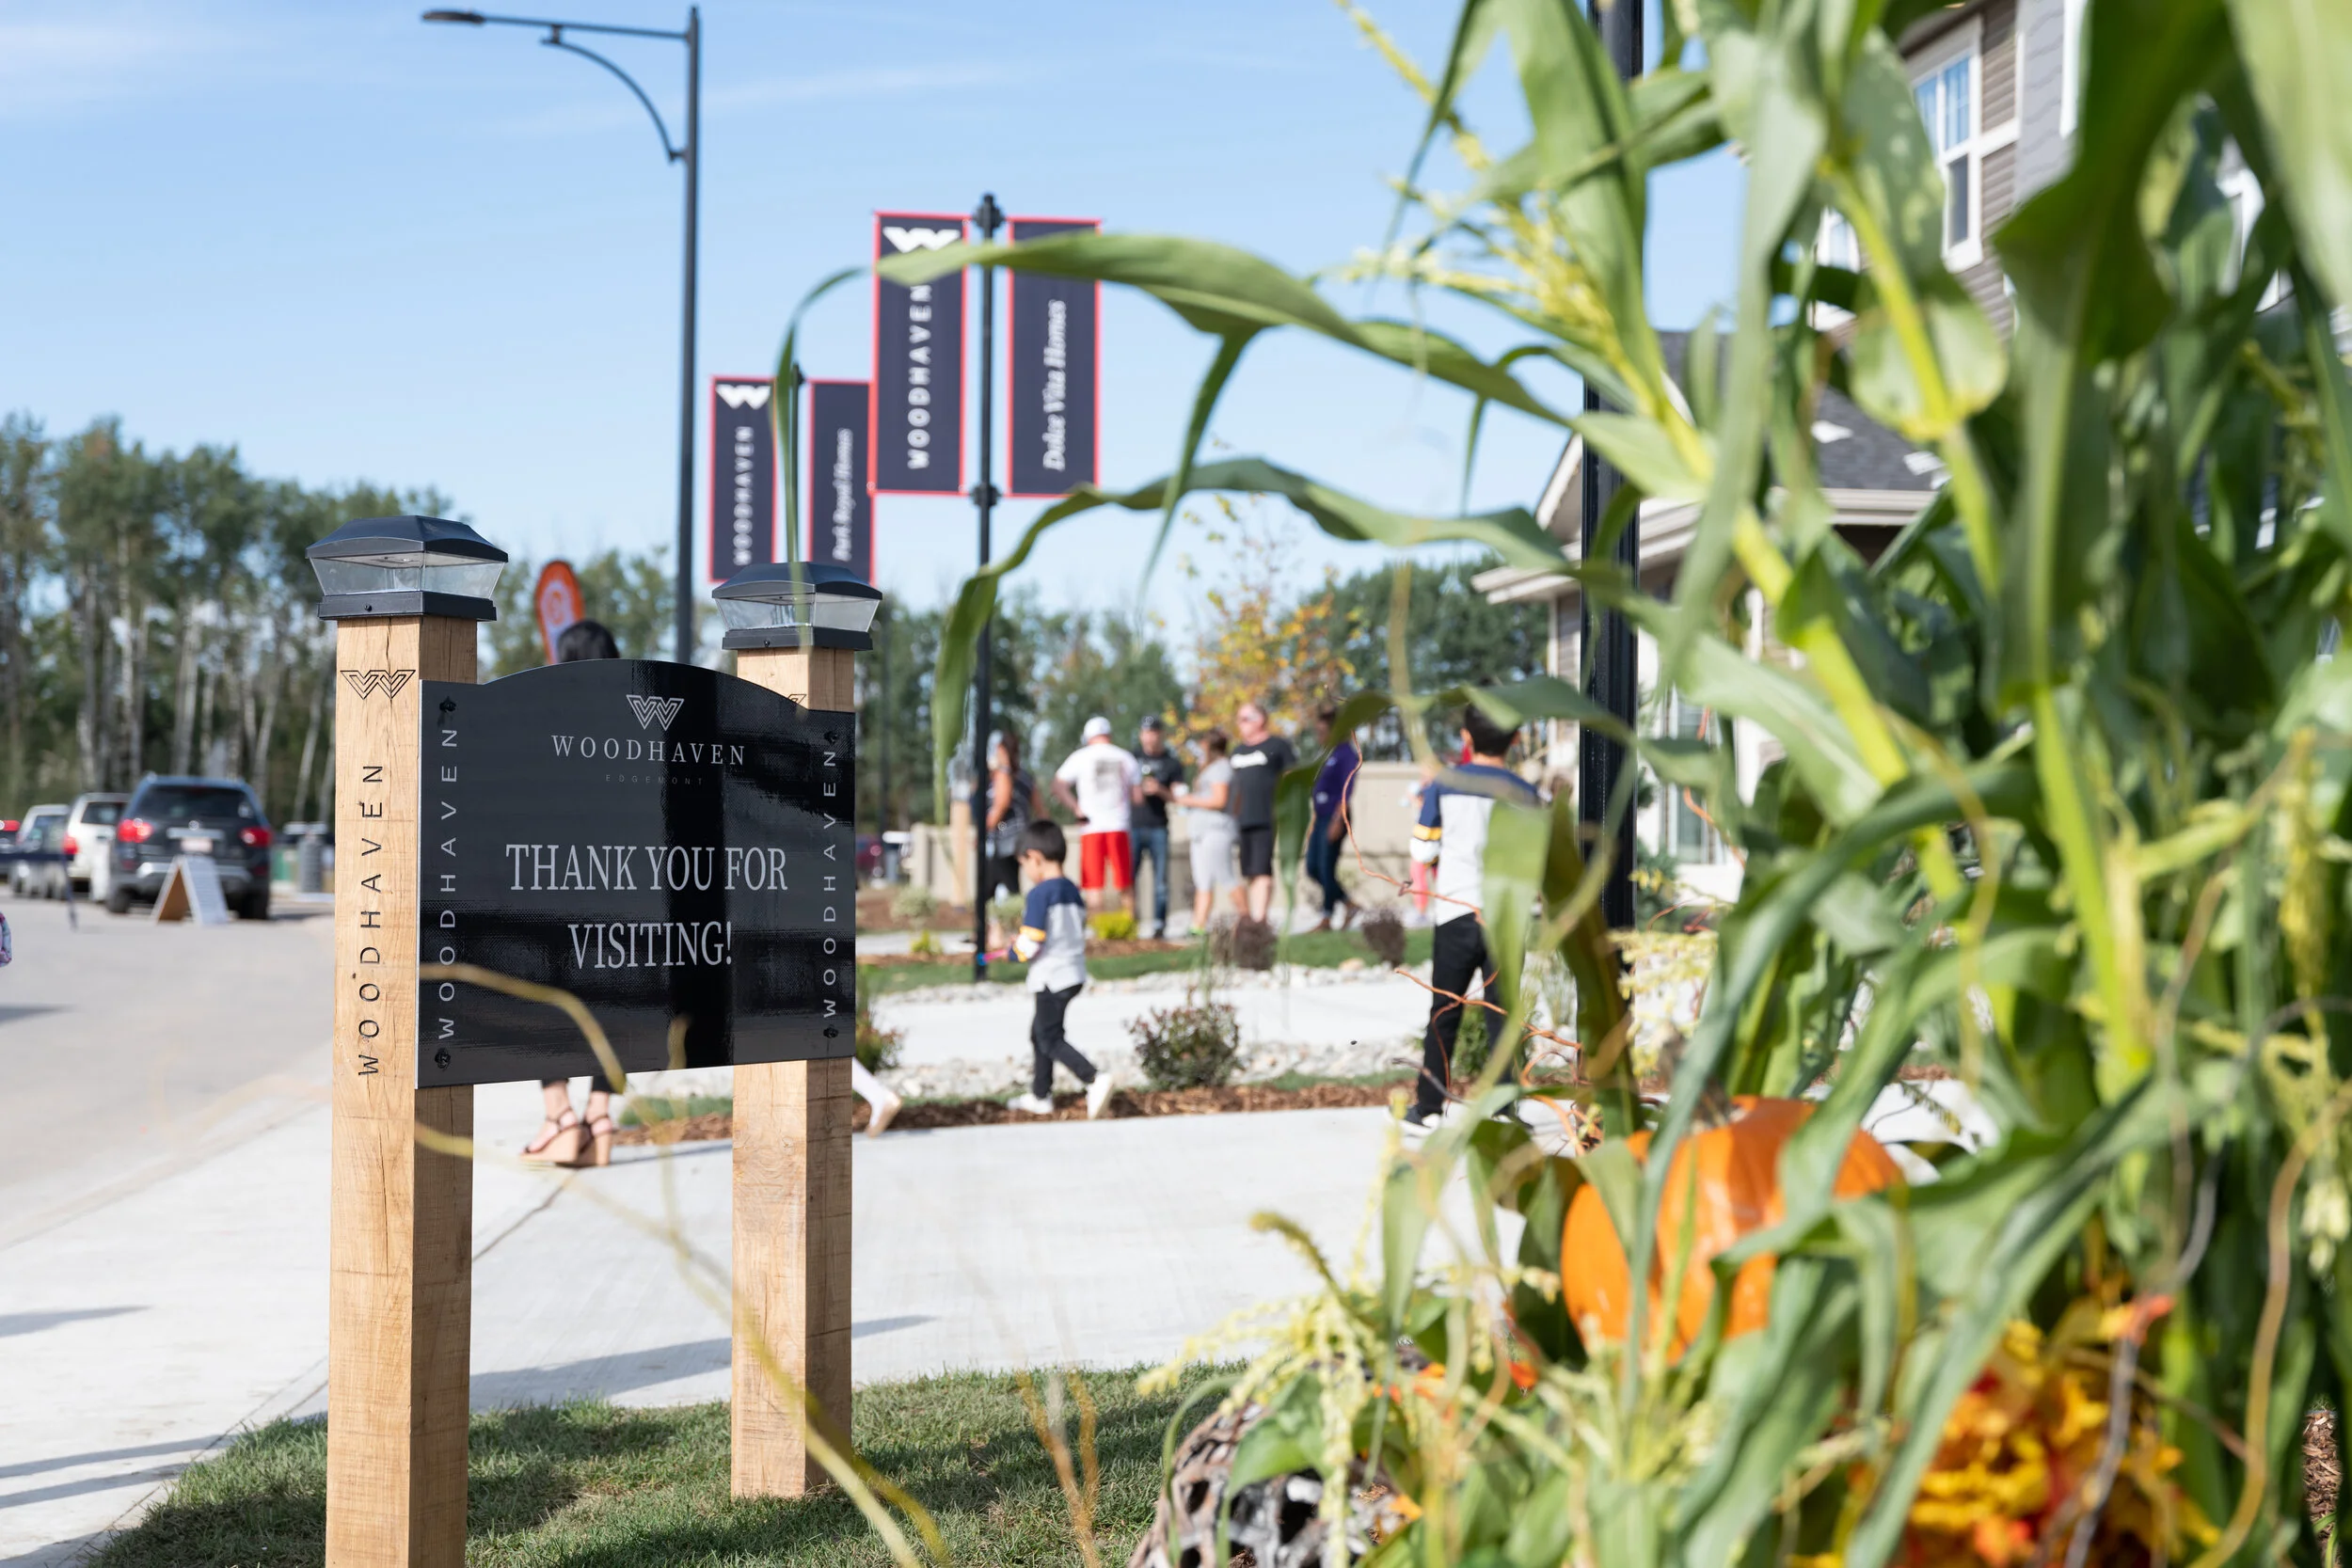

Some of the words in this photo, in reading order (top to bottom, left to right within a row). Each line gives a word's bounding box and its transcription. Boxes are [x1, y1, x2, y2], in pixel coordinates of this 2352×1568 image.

[1042, 299, 1067, 370] Homes
[907, 285, 931, 469] WOODHAVEN
[1041, 370, 1066, 413] Vita
[733, 426, 754, 565] WOODHAVEN
[551, 735, 745, 766] WOODHAVEN
[605, 774, 704, 785] EDGEMONT
[438, 730, 458, 1039] WOODHAVEN
[506, 844, 638, 891] THANK
[644, 847, 713, 891] YOU
[724, 847, 788, 891] FOR
[822, 751, 837, 1018] WOODHAVEN
[358, 766, 383, 1076] WOODHAVEN
[568, 921, 734, 970] VISITING!
